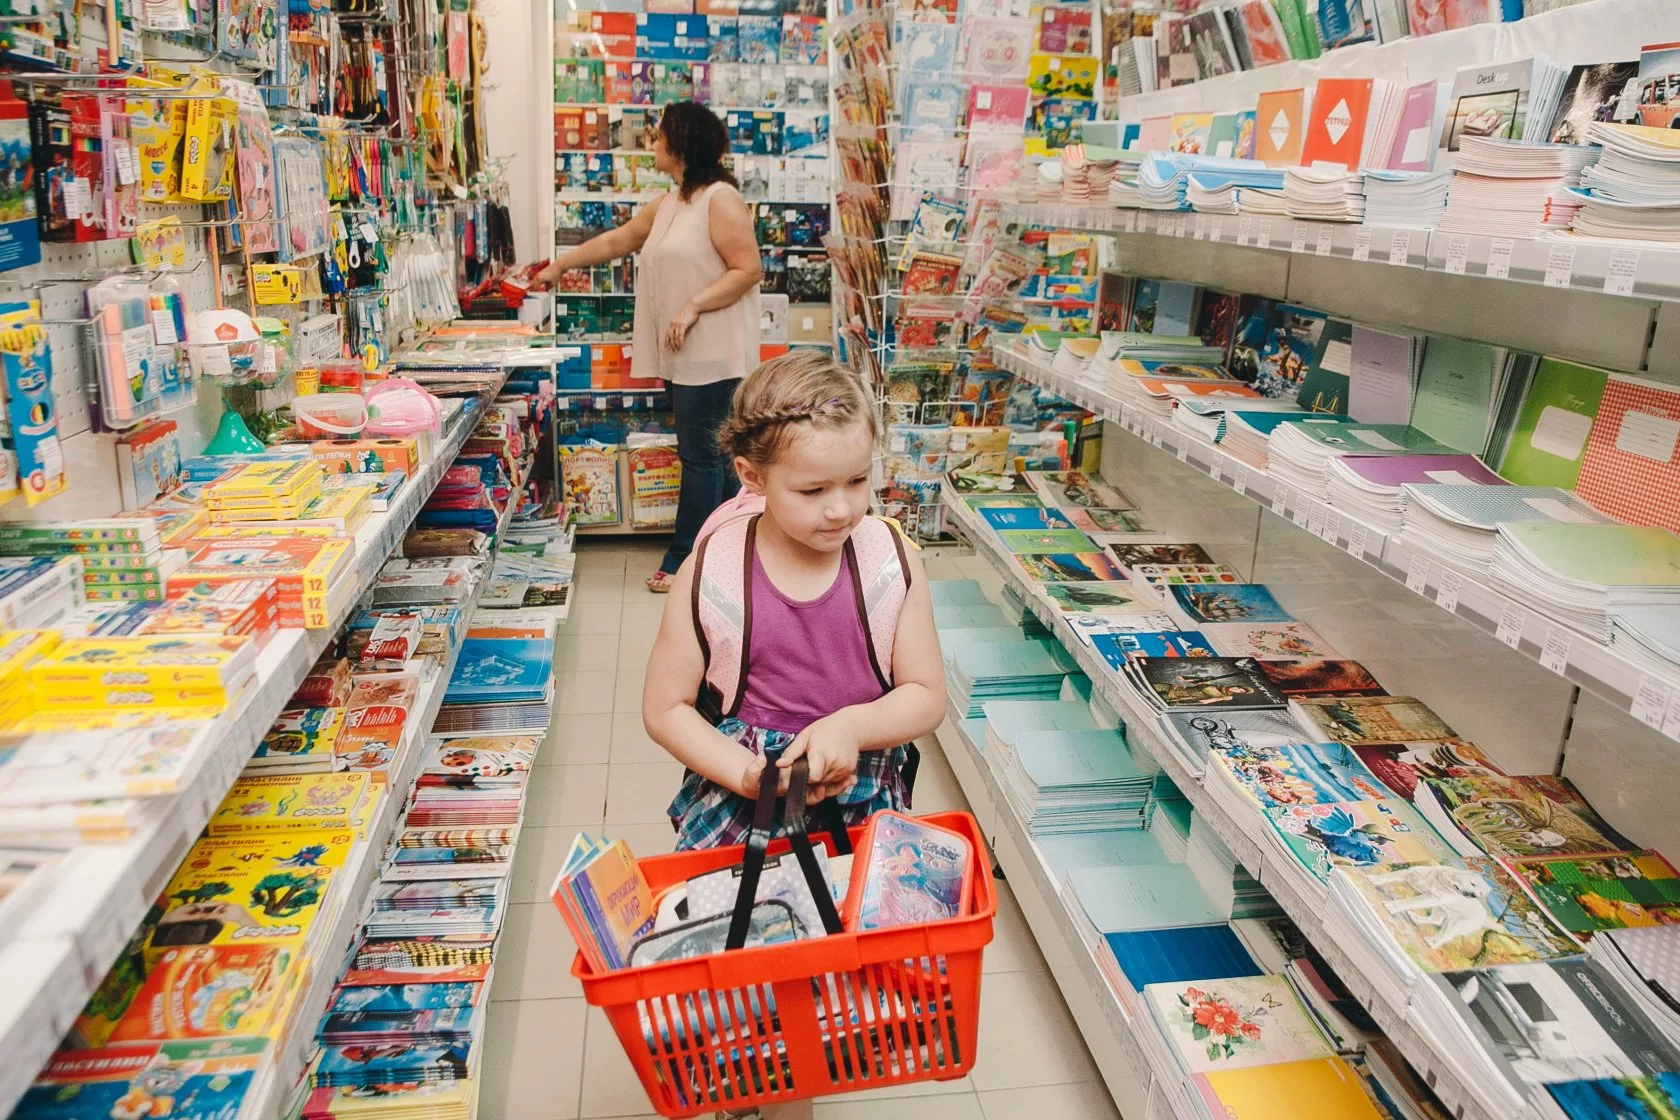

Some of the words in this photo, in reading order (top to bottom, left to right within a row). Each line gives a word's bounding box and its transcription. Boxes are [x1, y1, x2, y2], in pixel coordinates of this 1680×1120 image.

[308, 579, 322, 591] 12
[308, 597, 322, 609] 12
[310, 614, 324, 626] 12
[239, 776, 302, 784] ПЛАСТИЛИН
[620, 895, 641, 927] МИР
